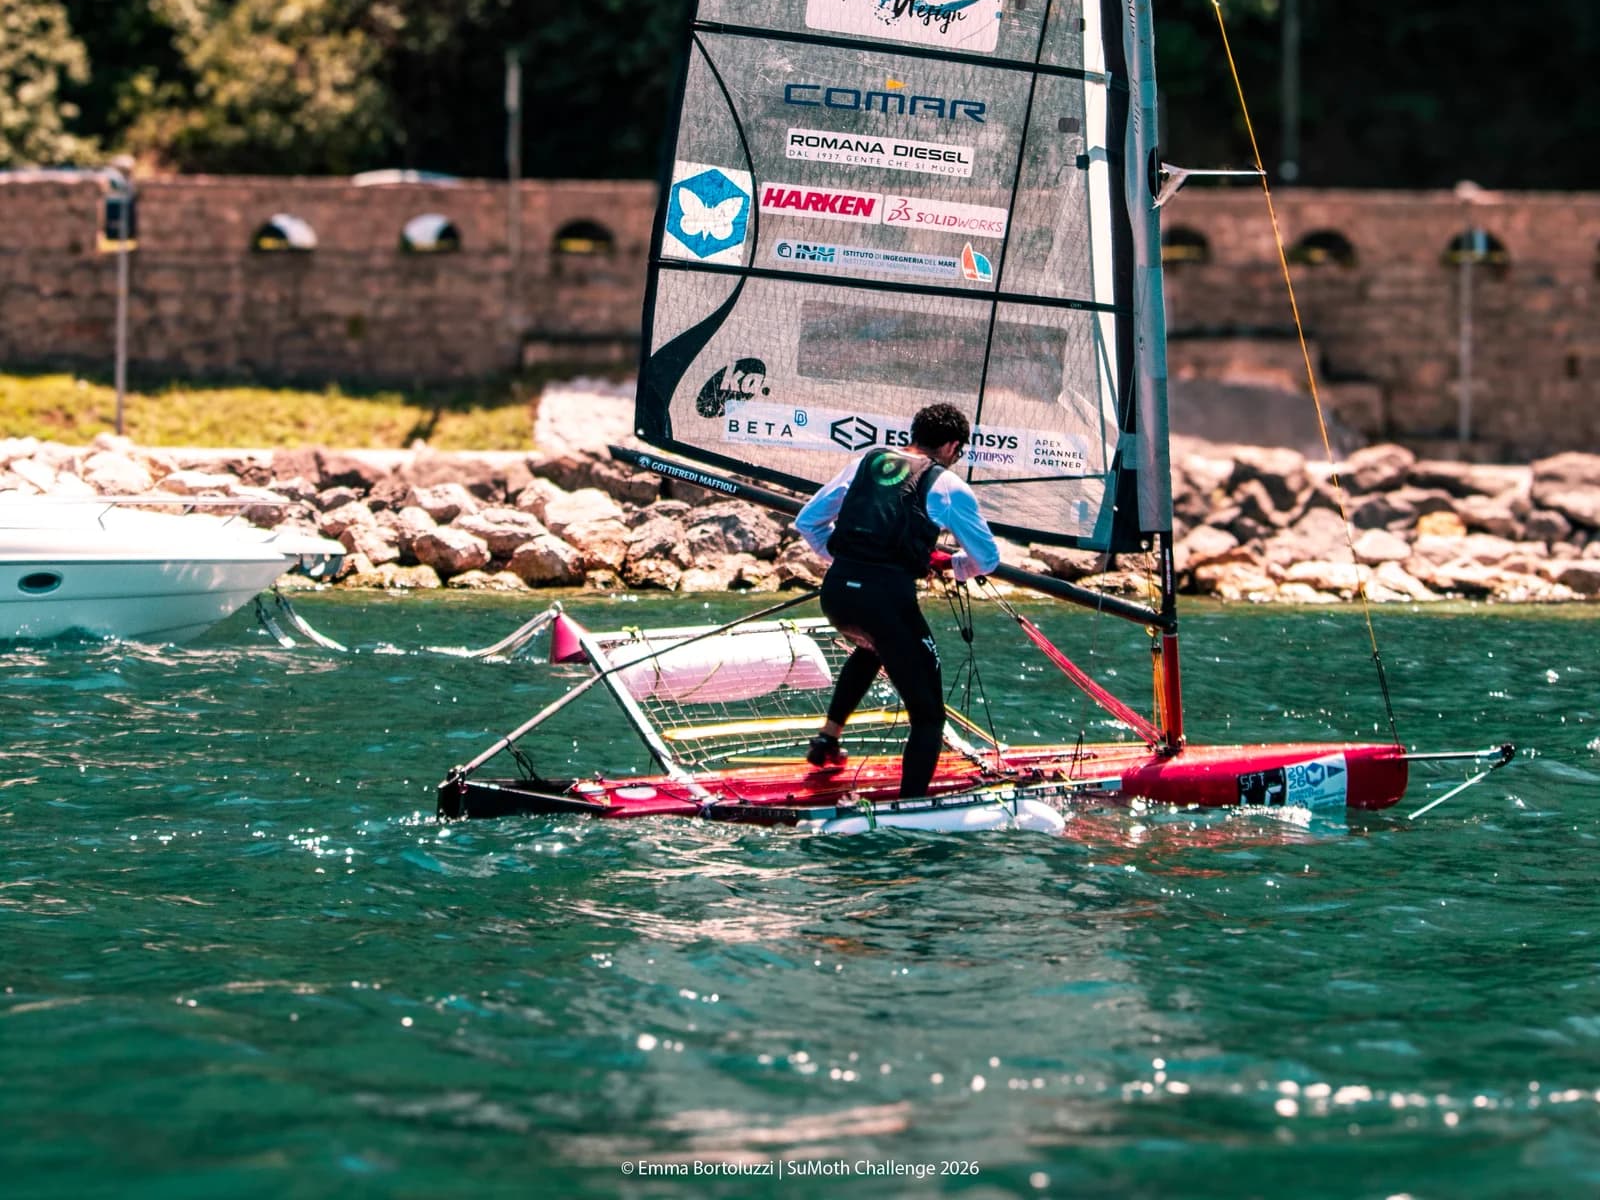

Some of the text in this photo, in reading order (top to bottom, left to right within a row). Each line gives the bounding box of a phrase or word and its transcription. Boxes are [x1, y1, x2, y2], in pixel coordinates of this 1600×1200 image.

[784, 83, 986, 123] COMAR
[790, 134, 969, 164] ROMANA DIESEL
[789, 150, 809, 158] DAL
[817, 152, 839, 161] 1937
[847, 155, 881, 165] GENTE
[888, 159, 909, 168] CHE
[932, 165, 968, 175] MUOVE
[762, 187, 876, 217] HARKEN
[916, 212, 1004, 233] SOLIDWORKS
[843, 250, 957, 268] ISTITUTO DI INGEGNERIA DEL MARE
[728, 419, 793, 437] BETA
[885, 430, 910, 448] ES
[967, 432, 1018, 449] nsys
[1035, 439, 1061, 447] APEX
[1034, 448, 1084, 460] CHANNEL
[1033, 459, 1082, 469] PARTNER
[651, 462, 737, 494] GOTTIFREDI MAFFIOLI
